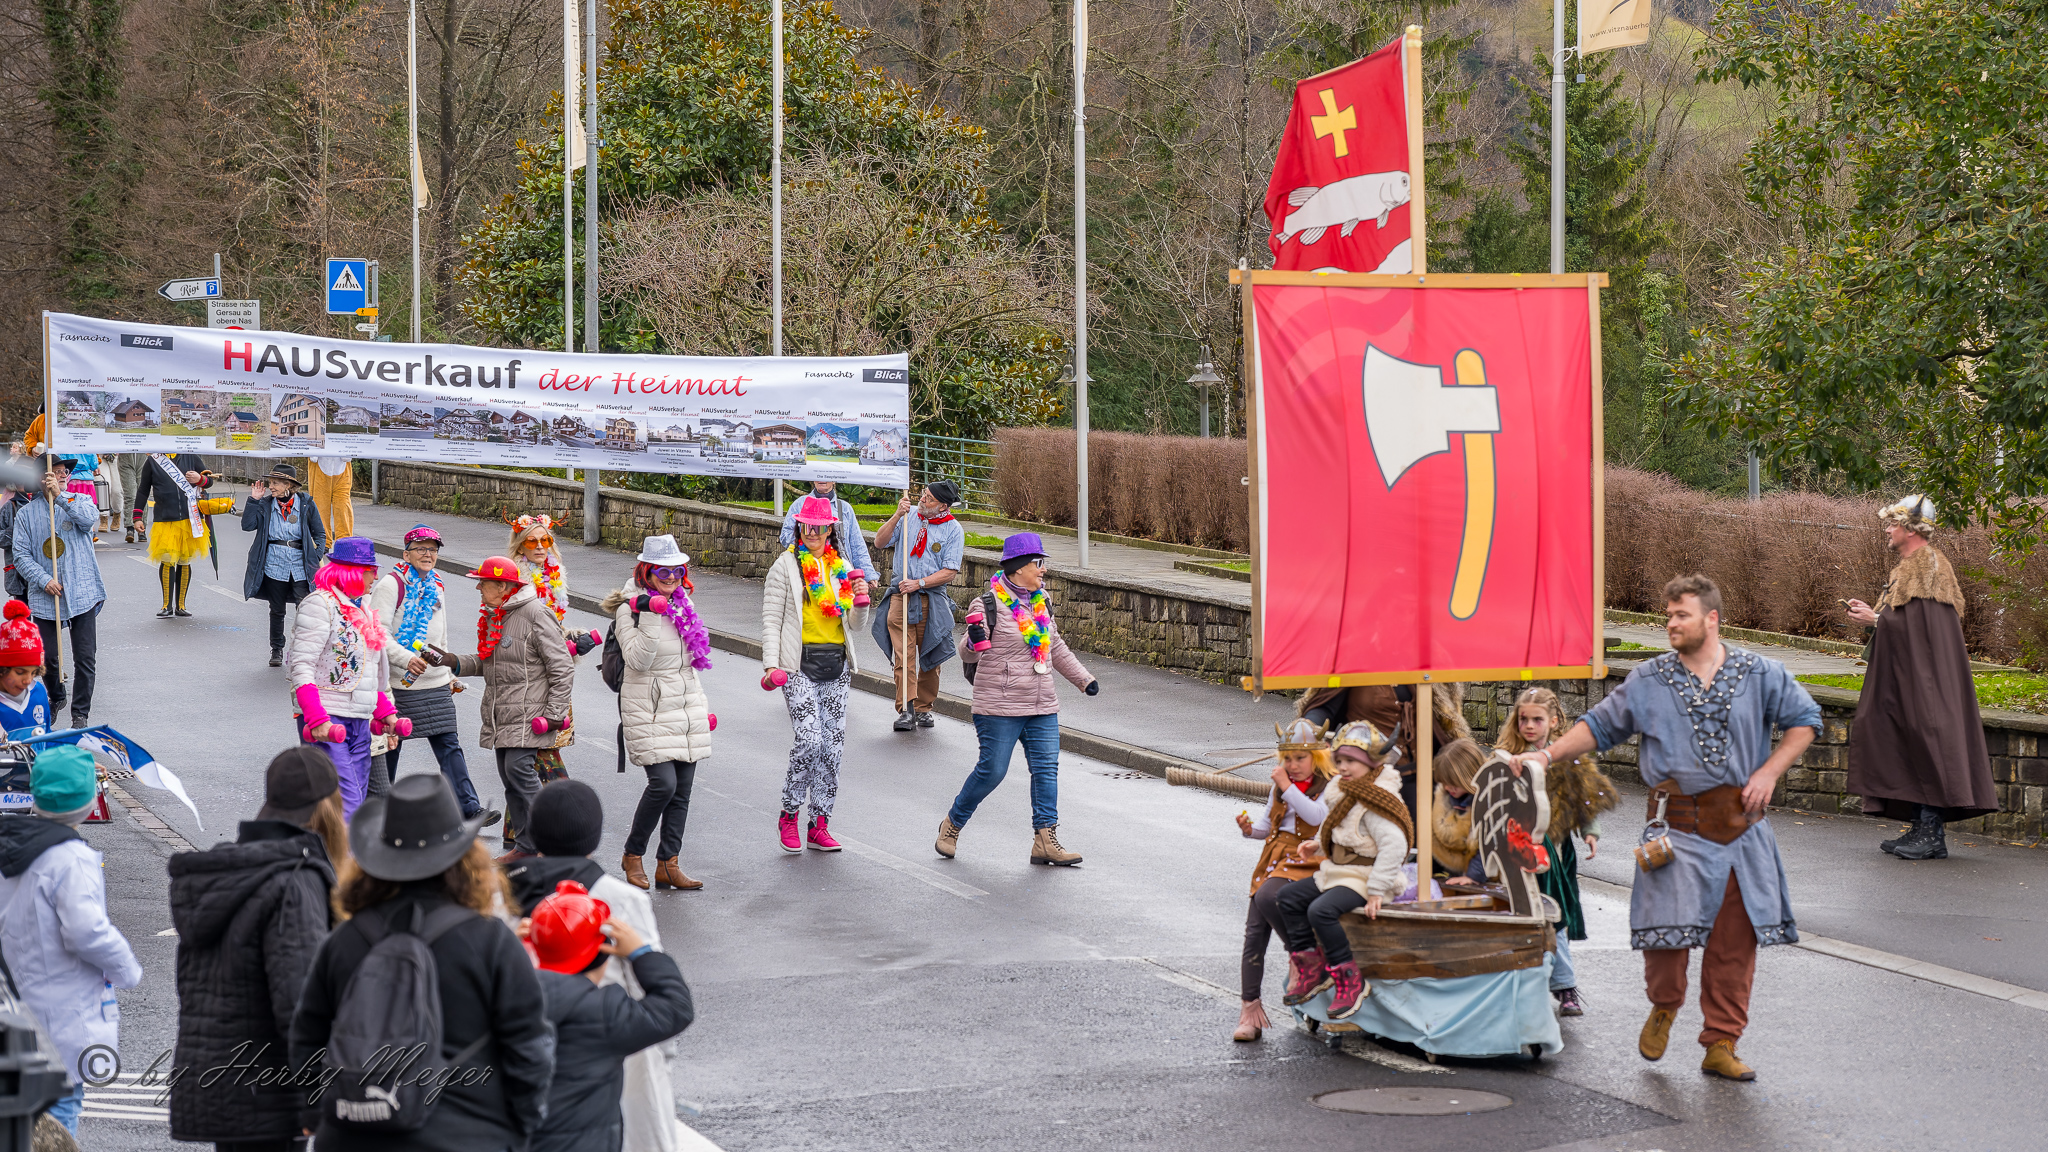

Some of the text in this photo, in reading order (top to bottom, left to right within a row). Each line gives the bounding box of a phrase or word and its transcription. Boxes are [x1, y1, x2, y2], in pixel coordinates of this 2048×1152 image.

[180, 282, 200, 296] Rigi
[239, 300, 257, 308] nach
[60, 333, 163, 347] Fasnachts Blick
[224, 340, 753, 397] HAUSverkauf der Heimat
[805, 370, 904, 380] Fasnachts Blick
[272, 383, 310, 391] HAUSverkauf
[381, 392, 419, 400] HAUSverkauf
